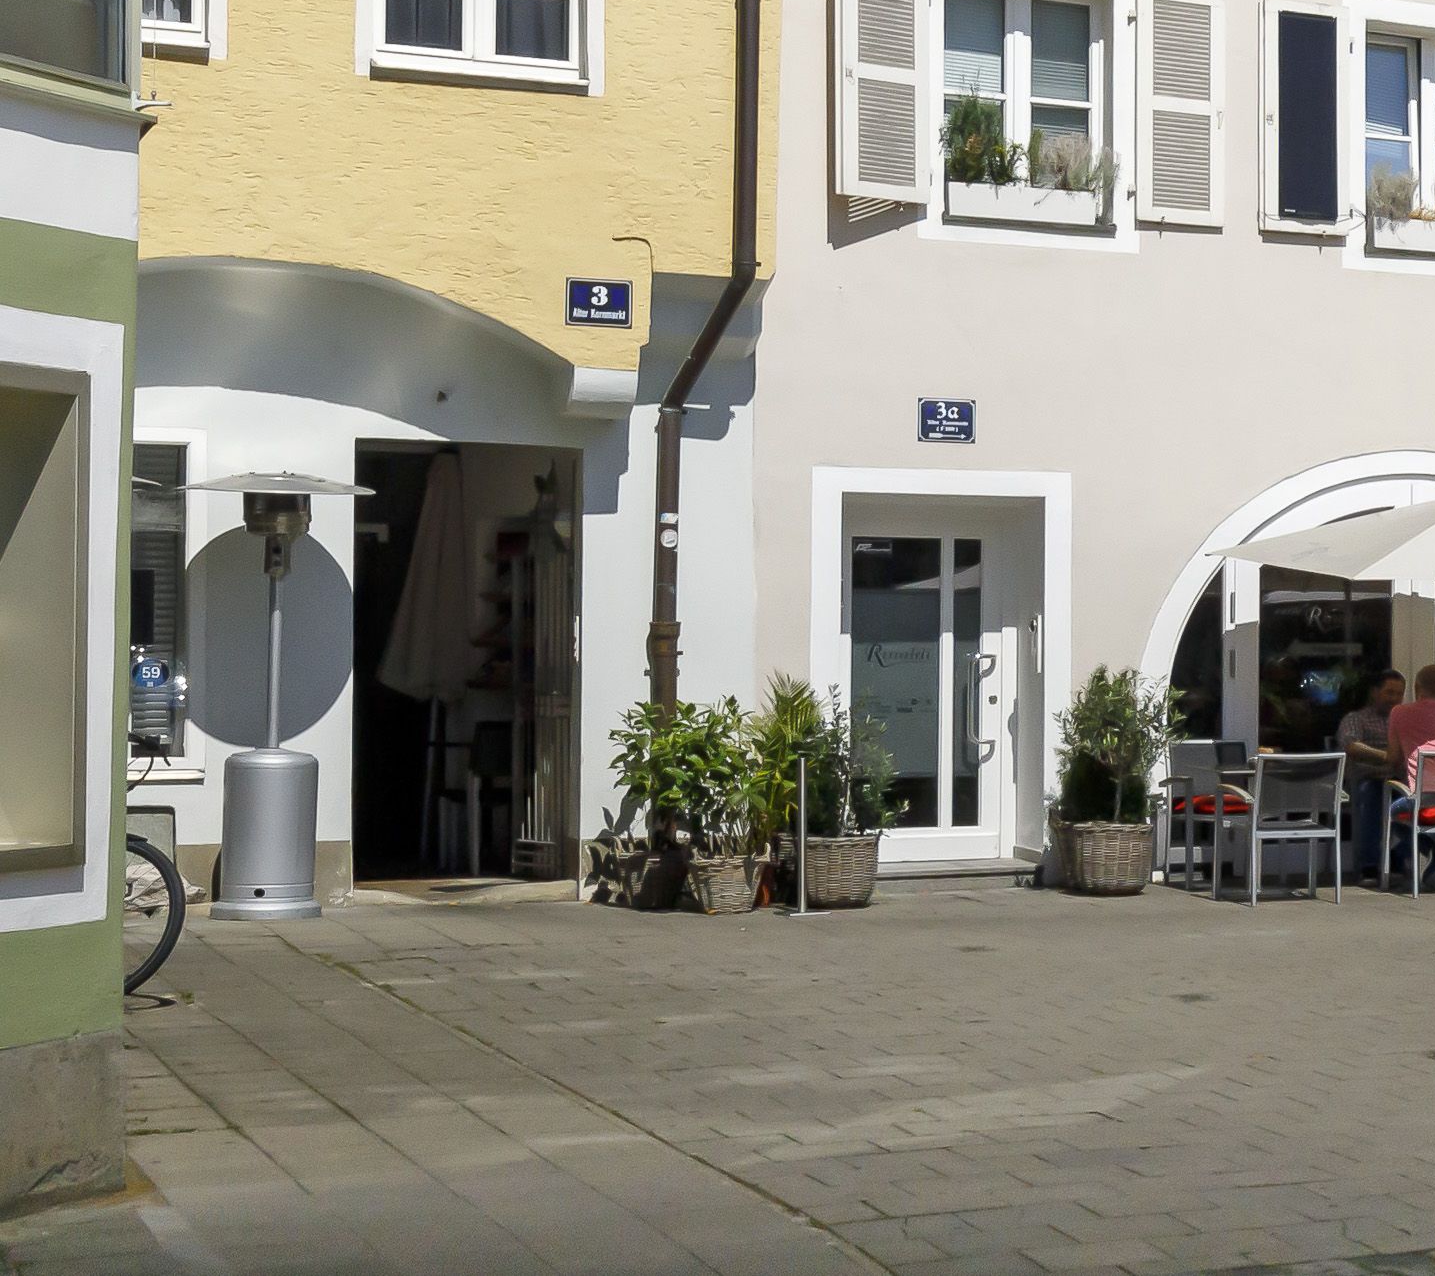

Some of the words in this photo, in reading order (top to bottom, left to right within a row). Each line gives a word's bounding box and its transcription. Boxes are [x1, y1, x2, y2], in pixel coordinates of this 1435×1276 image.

[591, 285, 608, 306] 3
[935, 402, 959, 419] 3a
[142, 666, 160, 679] 59
